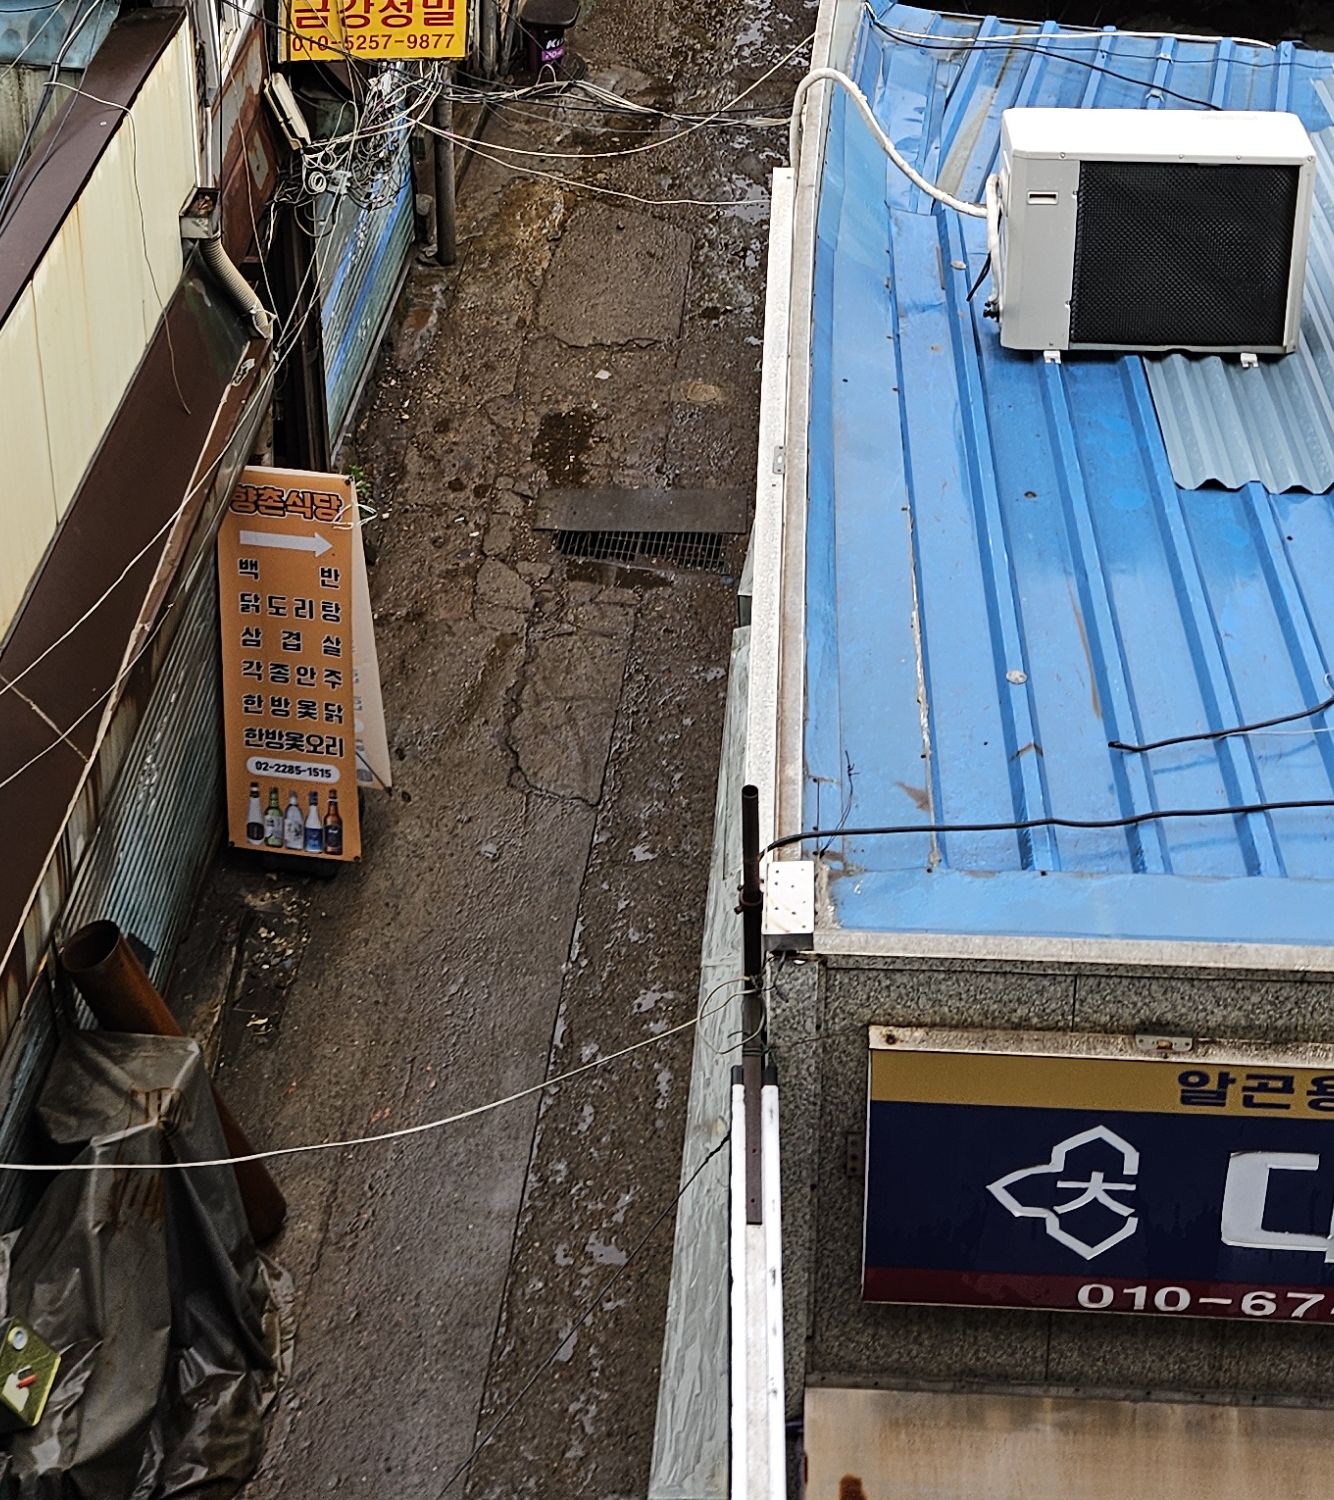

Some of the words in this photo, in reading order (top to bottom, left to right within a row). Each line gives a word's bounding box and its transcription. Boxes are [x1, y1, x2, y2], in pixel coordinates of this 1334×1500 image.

[292, 33, 455, 52] 010-5257-9877
[230, 483, 343, 523] 향촌식당
[255, 760, 332, 780] 02-2285-1515
